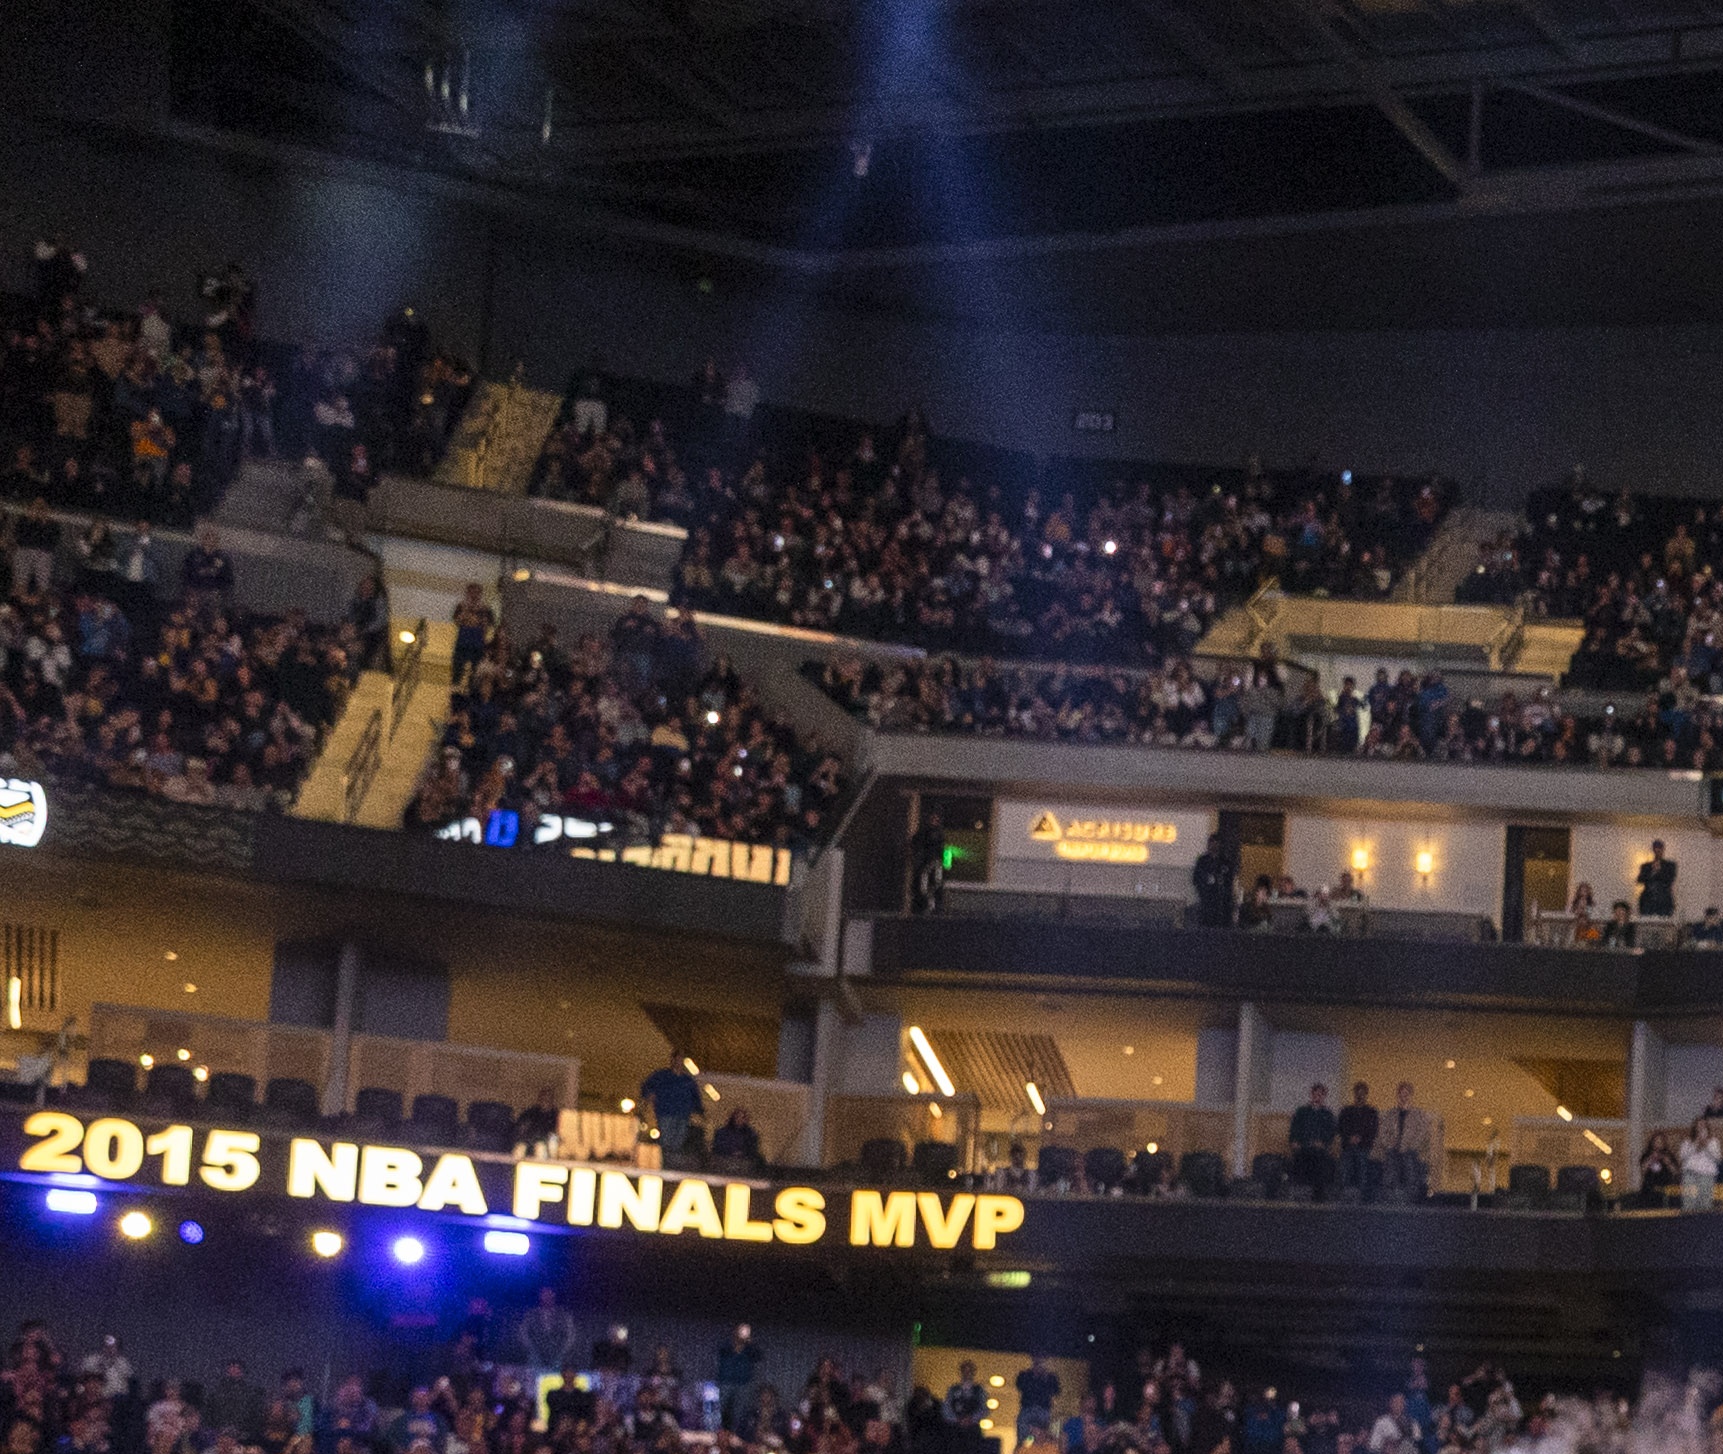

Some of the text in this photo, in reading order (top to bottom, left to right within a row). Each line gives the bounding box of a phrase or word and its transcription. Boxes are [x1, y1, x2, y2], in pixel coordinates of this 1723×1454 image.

[19, 1110, 1027, 1250] 2015 NBA FINALS MVP
